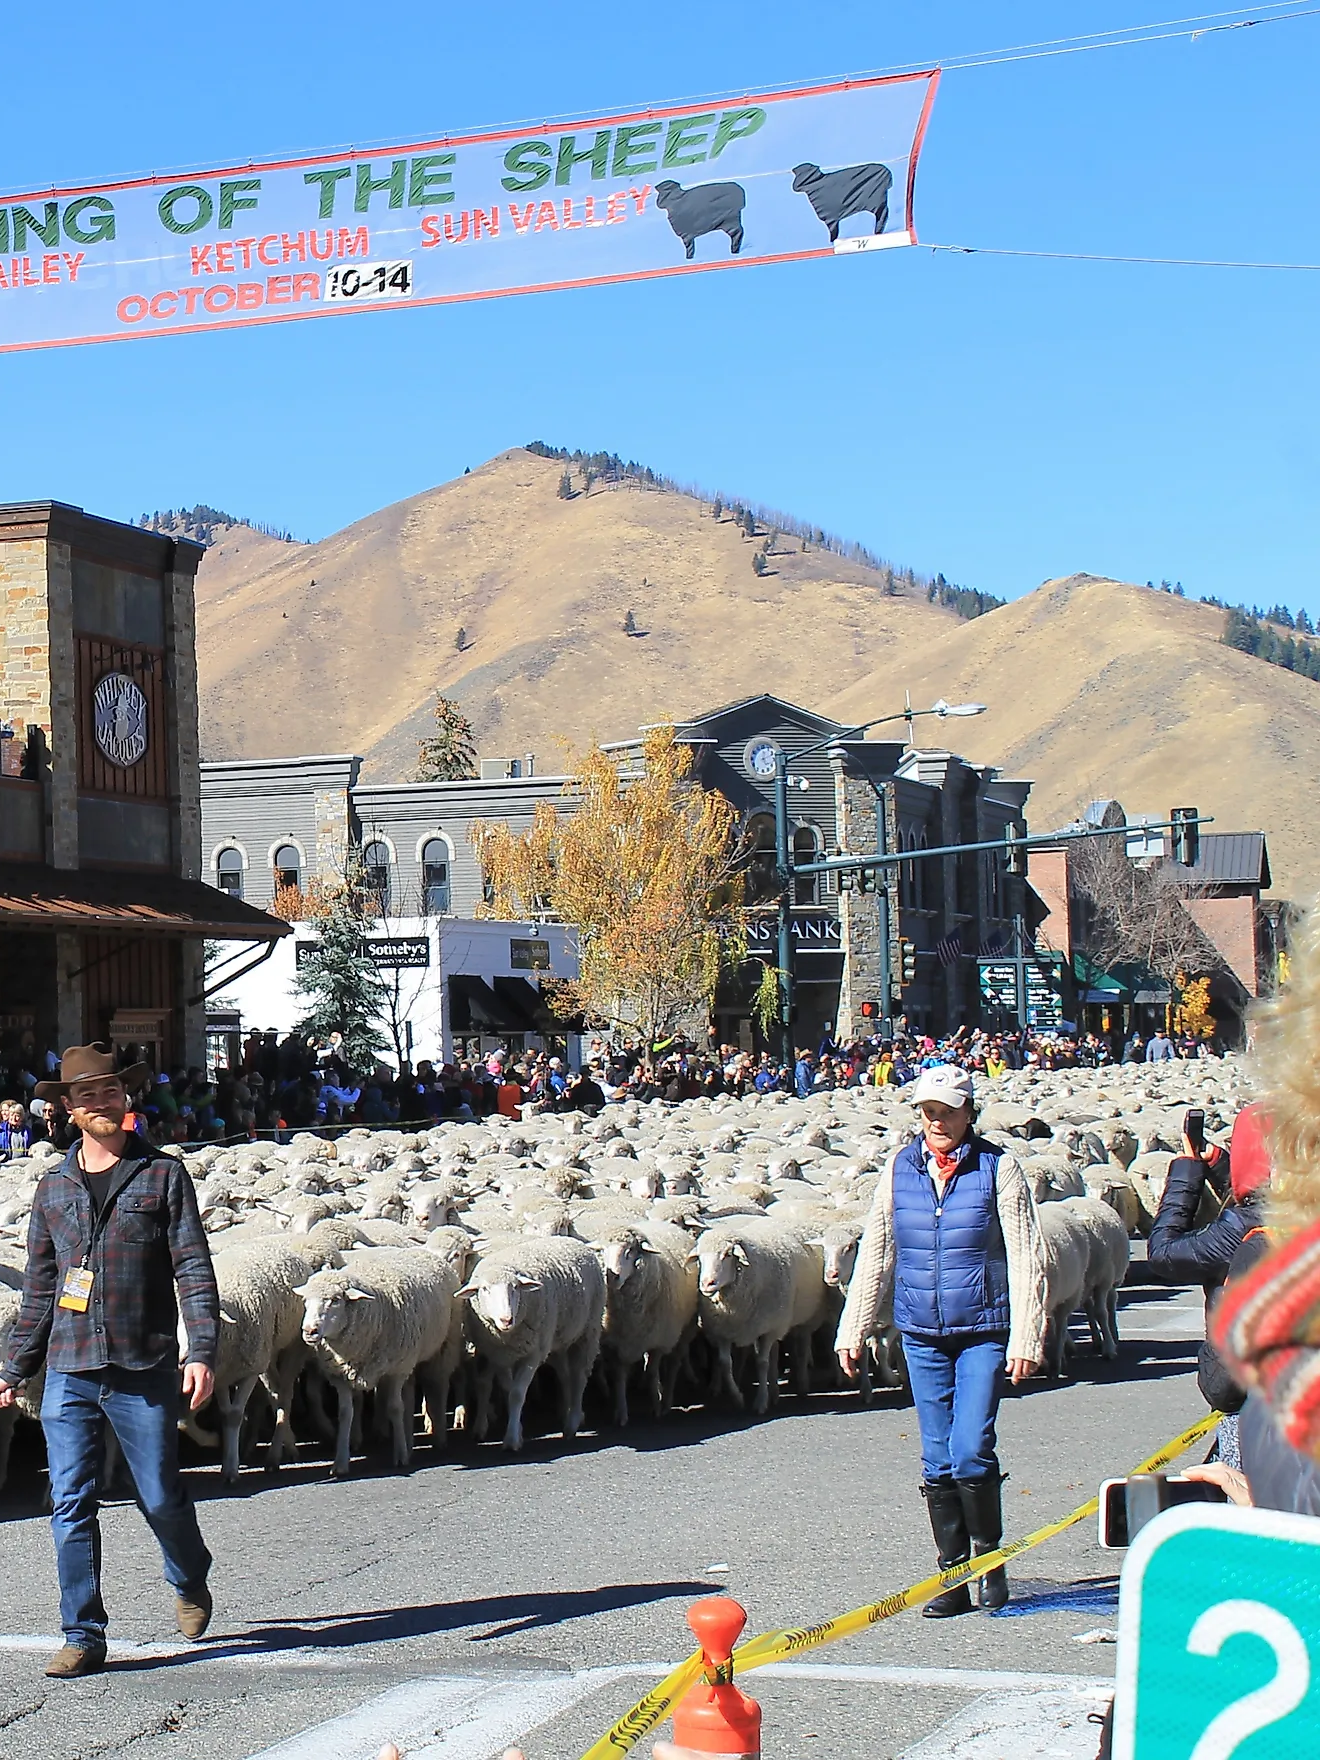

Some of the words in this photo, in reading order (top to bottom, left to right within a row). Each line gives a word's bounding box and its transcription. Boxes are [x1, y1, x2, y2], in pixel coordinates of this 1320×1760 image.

[158, 179, 262, 235] OF
[304, 153, 456, 219] THE
[501, 107, 767, 192] SHEEP
[191, 226, 369, 276] KETCHUM
[421, 206, 500, 248] SUN
[509, 184, 651, 235] VALLEY
[116, 272, 320, 323] OCTOBER
[95, 676, 147, 721] WHISKEY
[368, 942, 427, 958] Sotheby's
